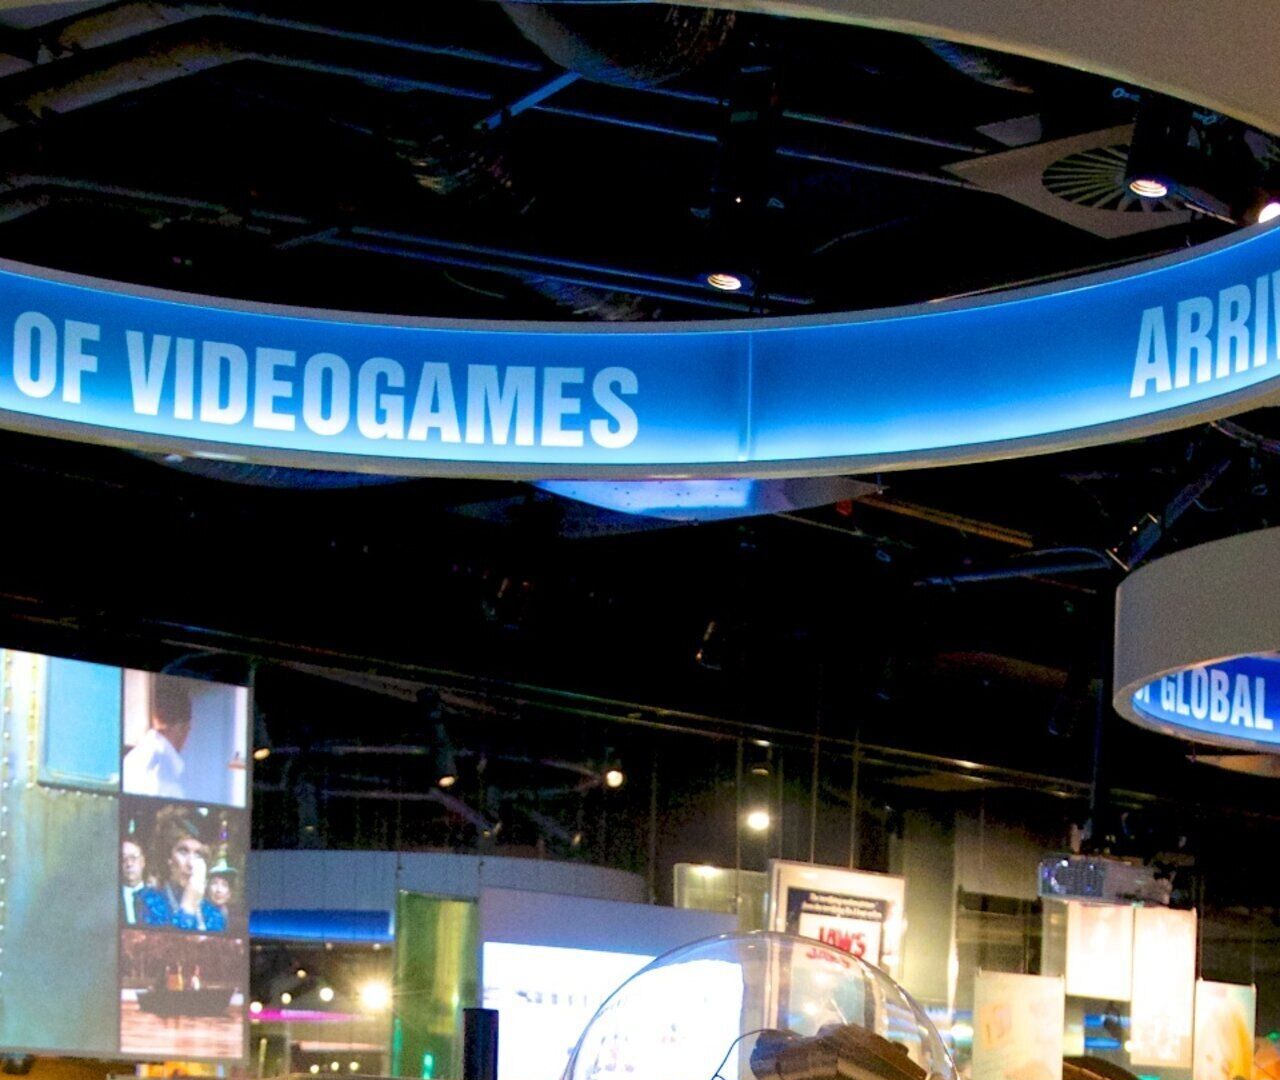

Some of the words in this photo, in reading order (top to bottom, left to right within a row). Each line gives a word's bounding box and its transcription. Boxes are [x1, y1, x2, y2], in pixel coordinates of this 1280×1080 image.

[13, 311, 100, 404] OF
[125, 329, 639, 448] VIDEOGAMES
[1161, 666, 1274, 730] GLOBAL
